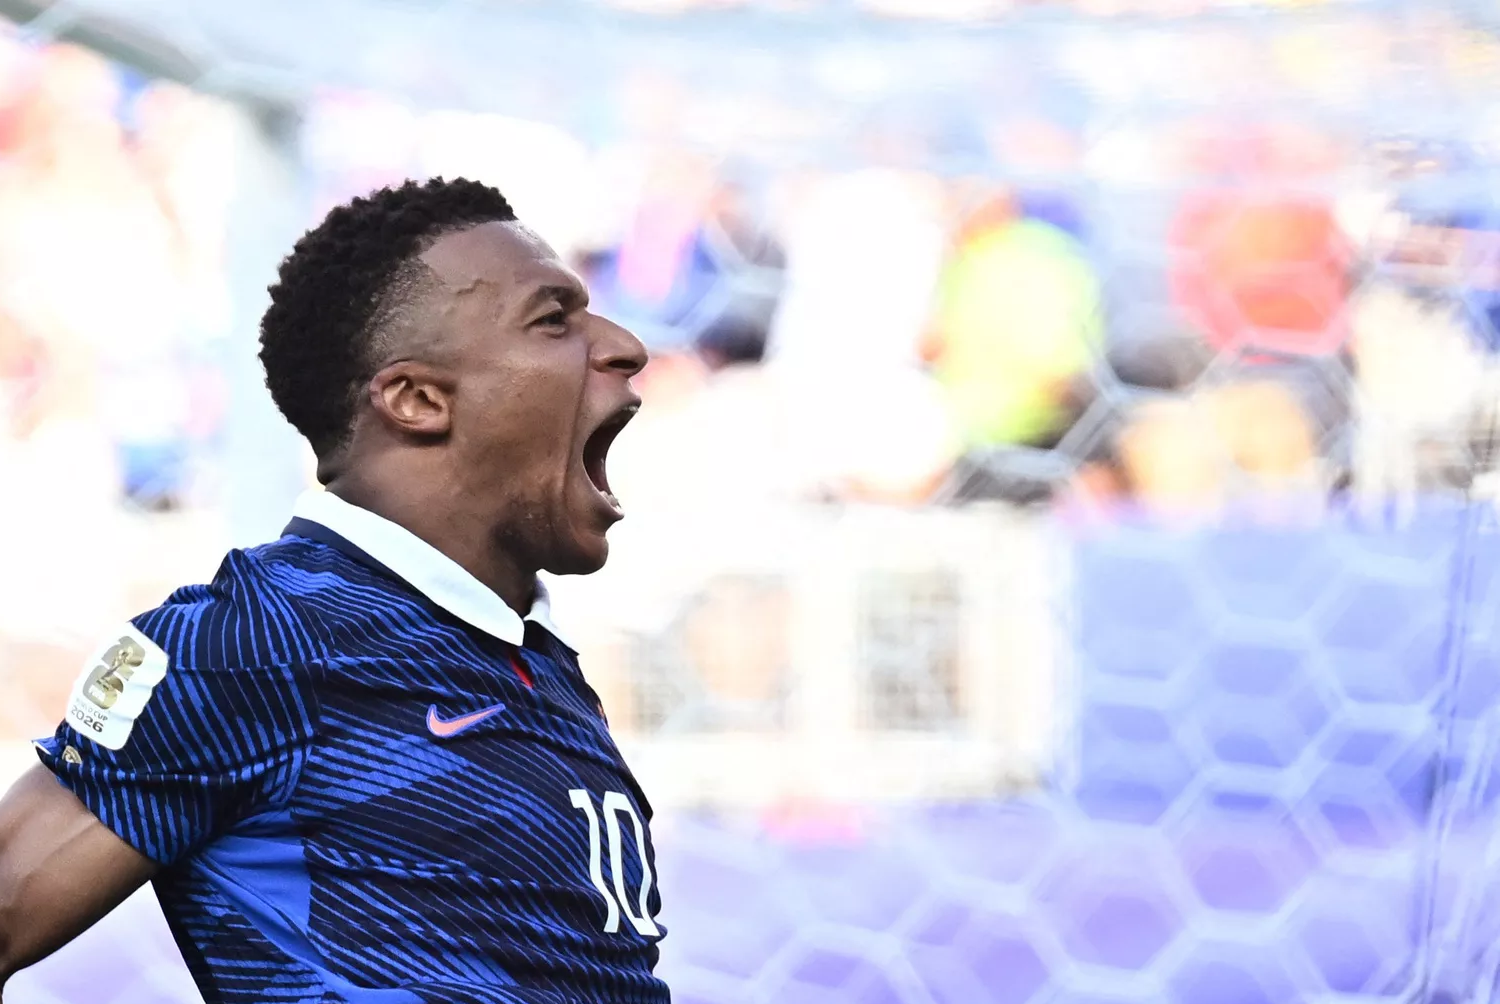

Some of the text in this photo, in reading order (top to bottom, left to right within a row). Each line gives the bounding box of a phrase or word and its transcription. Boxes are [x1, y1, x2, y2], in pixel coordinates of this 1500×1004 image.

[71, 704, 104, 733] 2026
[93, 710, 109, 722] CUP
[567, 788, 661, 937] 10
